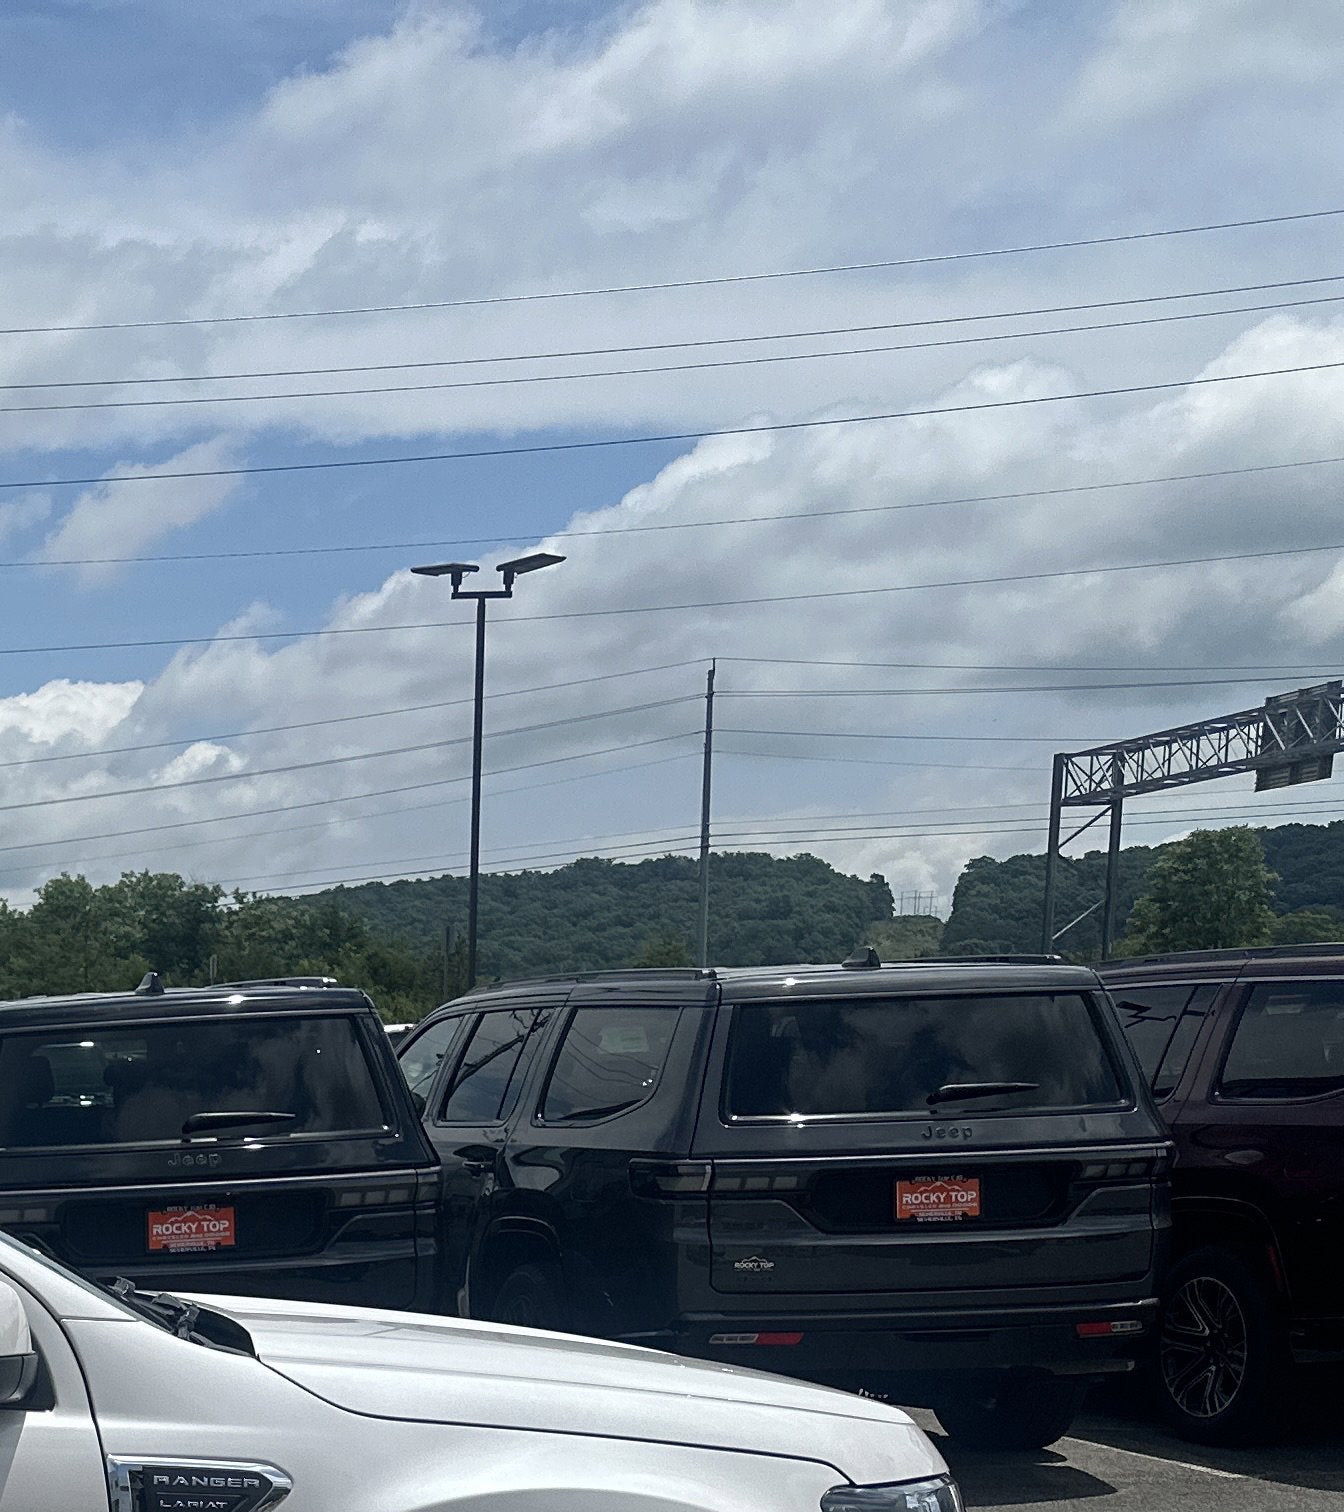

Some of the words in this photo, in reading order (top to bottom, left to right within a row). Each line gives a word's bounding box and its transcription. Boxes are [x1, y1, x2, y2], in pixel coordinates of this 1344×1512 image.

[920, 1124, 973, 1140] Jeep
[168, 1152, 221, 1168] Jeep
[902, 1191, 947, 1205] ROCKY
[949, 1190, 977, 1203] TOP
[152, 1222, 199, 1236] ROCKY
[200, 1220, 229, 1233] TOP
[153, 1475, 260, 1489] RANGER
[159, 1499, 229, 1510] LARIAT
